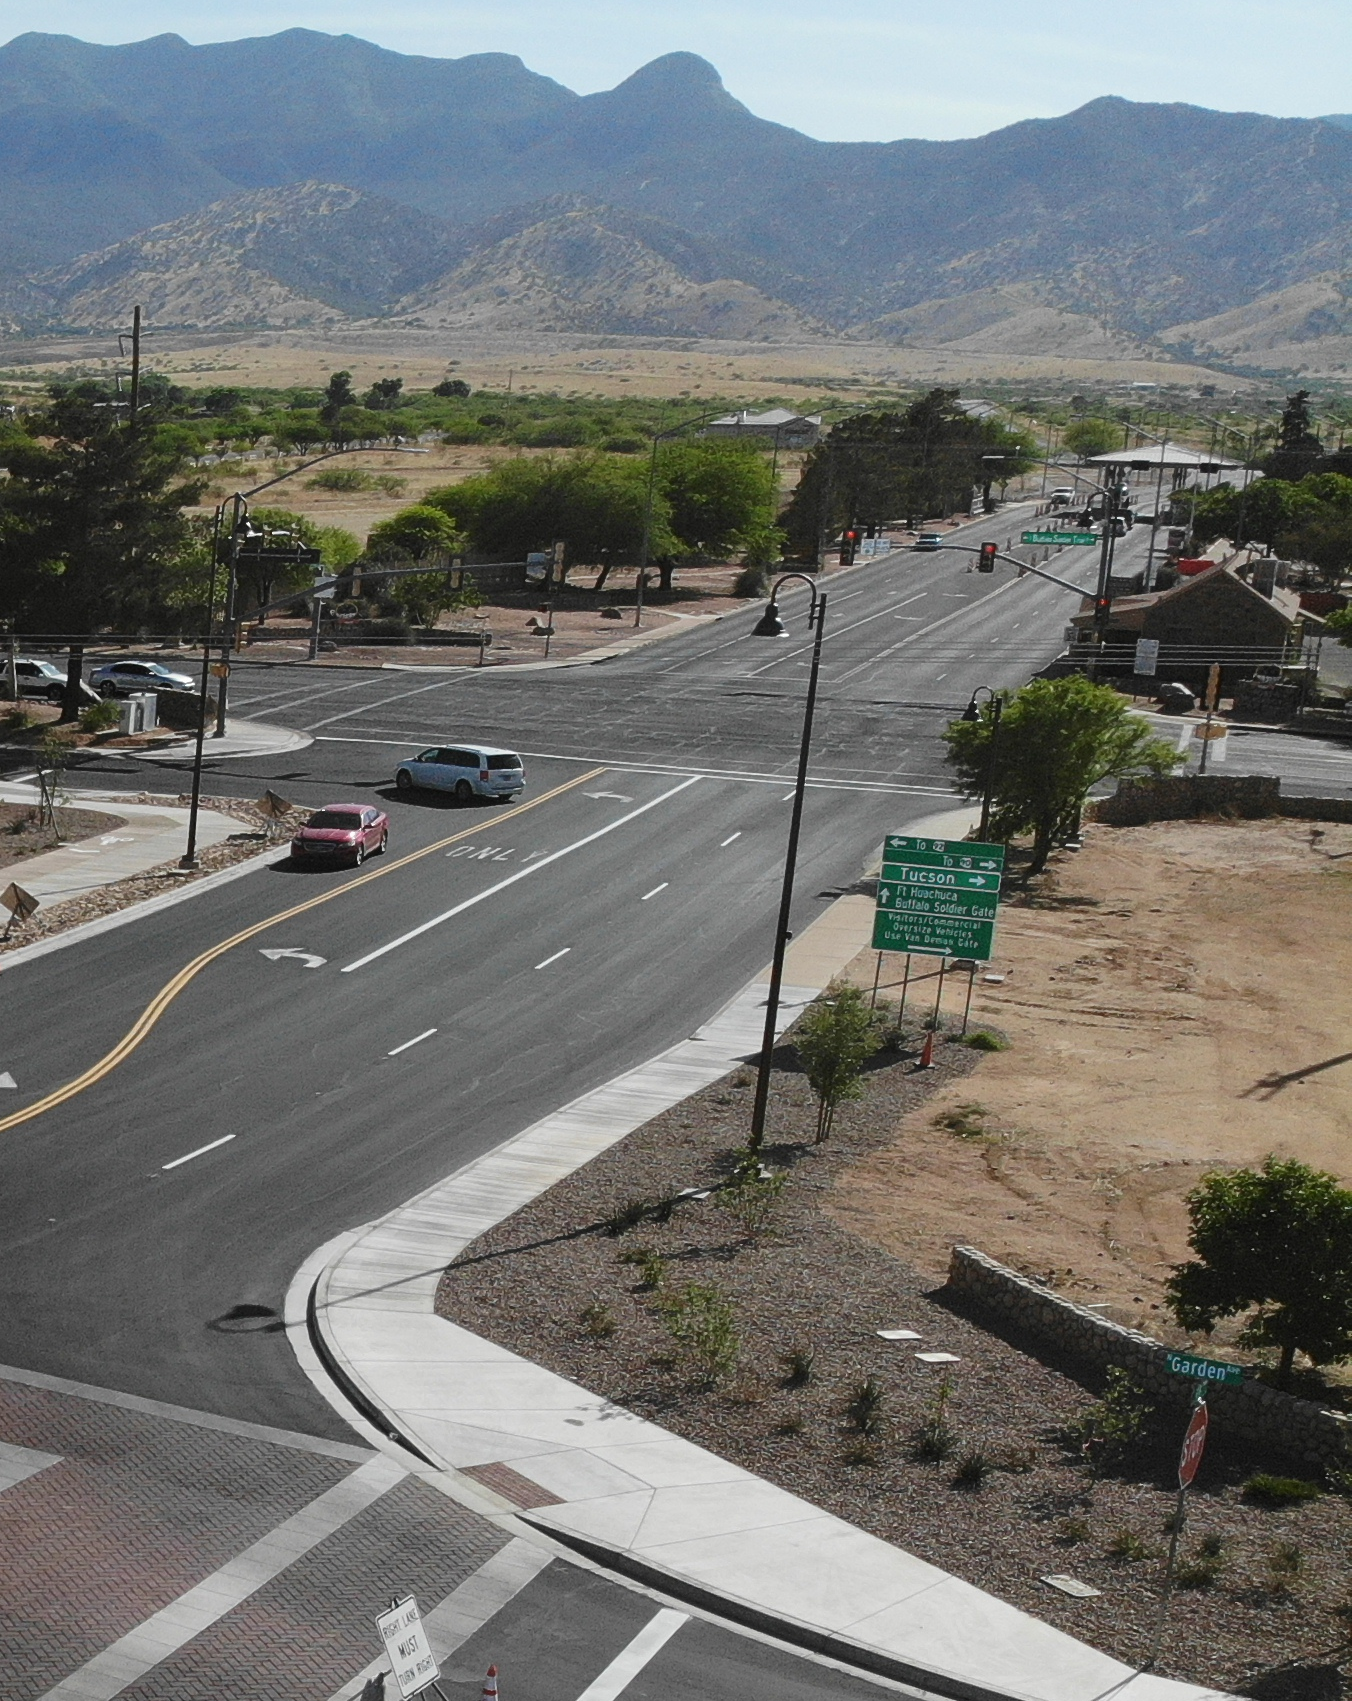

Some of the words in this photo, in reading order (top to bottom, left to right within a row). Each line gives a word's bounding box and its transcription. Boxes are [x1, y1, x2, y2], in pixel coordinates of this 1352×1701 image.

[916, 839, 926, 850] To
[445, 845, 548, 863] ONLY
[942, 855, 953, 866] To
[900, 867, 955, 884] Tucson
[897, 885, 907, 896] Ft
[910, 887, 957, 901] Huachuca
[895, 898, 930, 911] Buffalo
[933, 902, 967, 915] Soldier
[971, 905, 994, 918] Gate
[888, 913, 981, 930] Visitors/Commercial
[884, 931, 901, 940] Use
[905, 933, 920, 942] Van
[893, 922, 932, 934] Oversize
[936, 926, 973, 939] Vehicles
[1171, 1356, 1226, 1381] Garden
[1182, 1424, 1205, 1468] STOP
[382, 1618, 402, 1641] RIGHT
[401, 1607, 420, 1628] LANE
[397, 1635, 420, 1660] MUST
[398, 1667, 416, 1688] TURN
[416, 1654, 434, 1675] RIGHT
